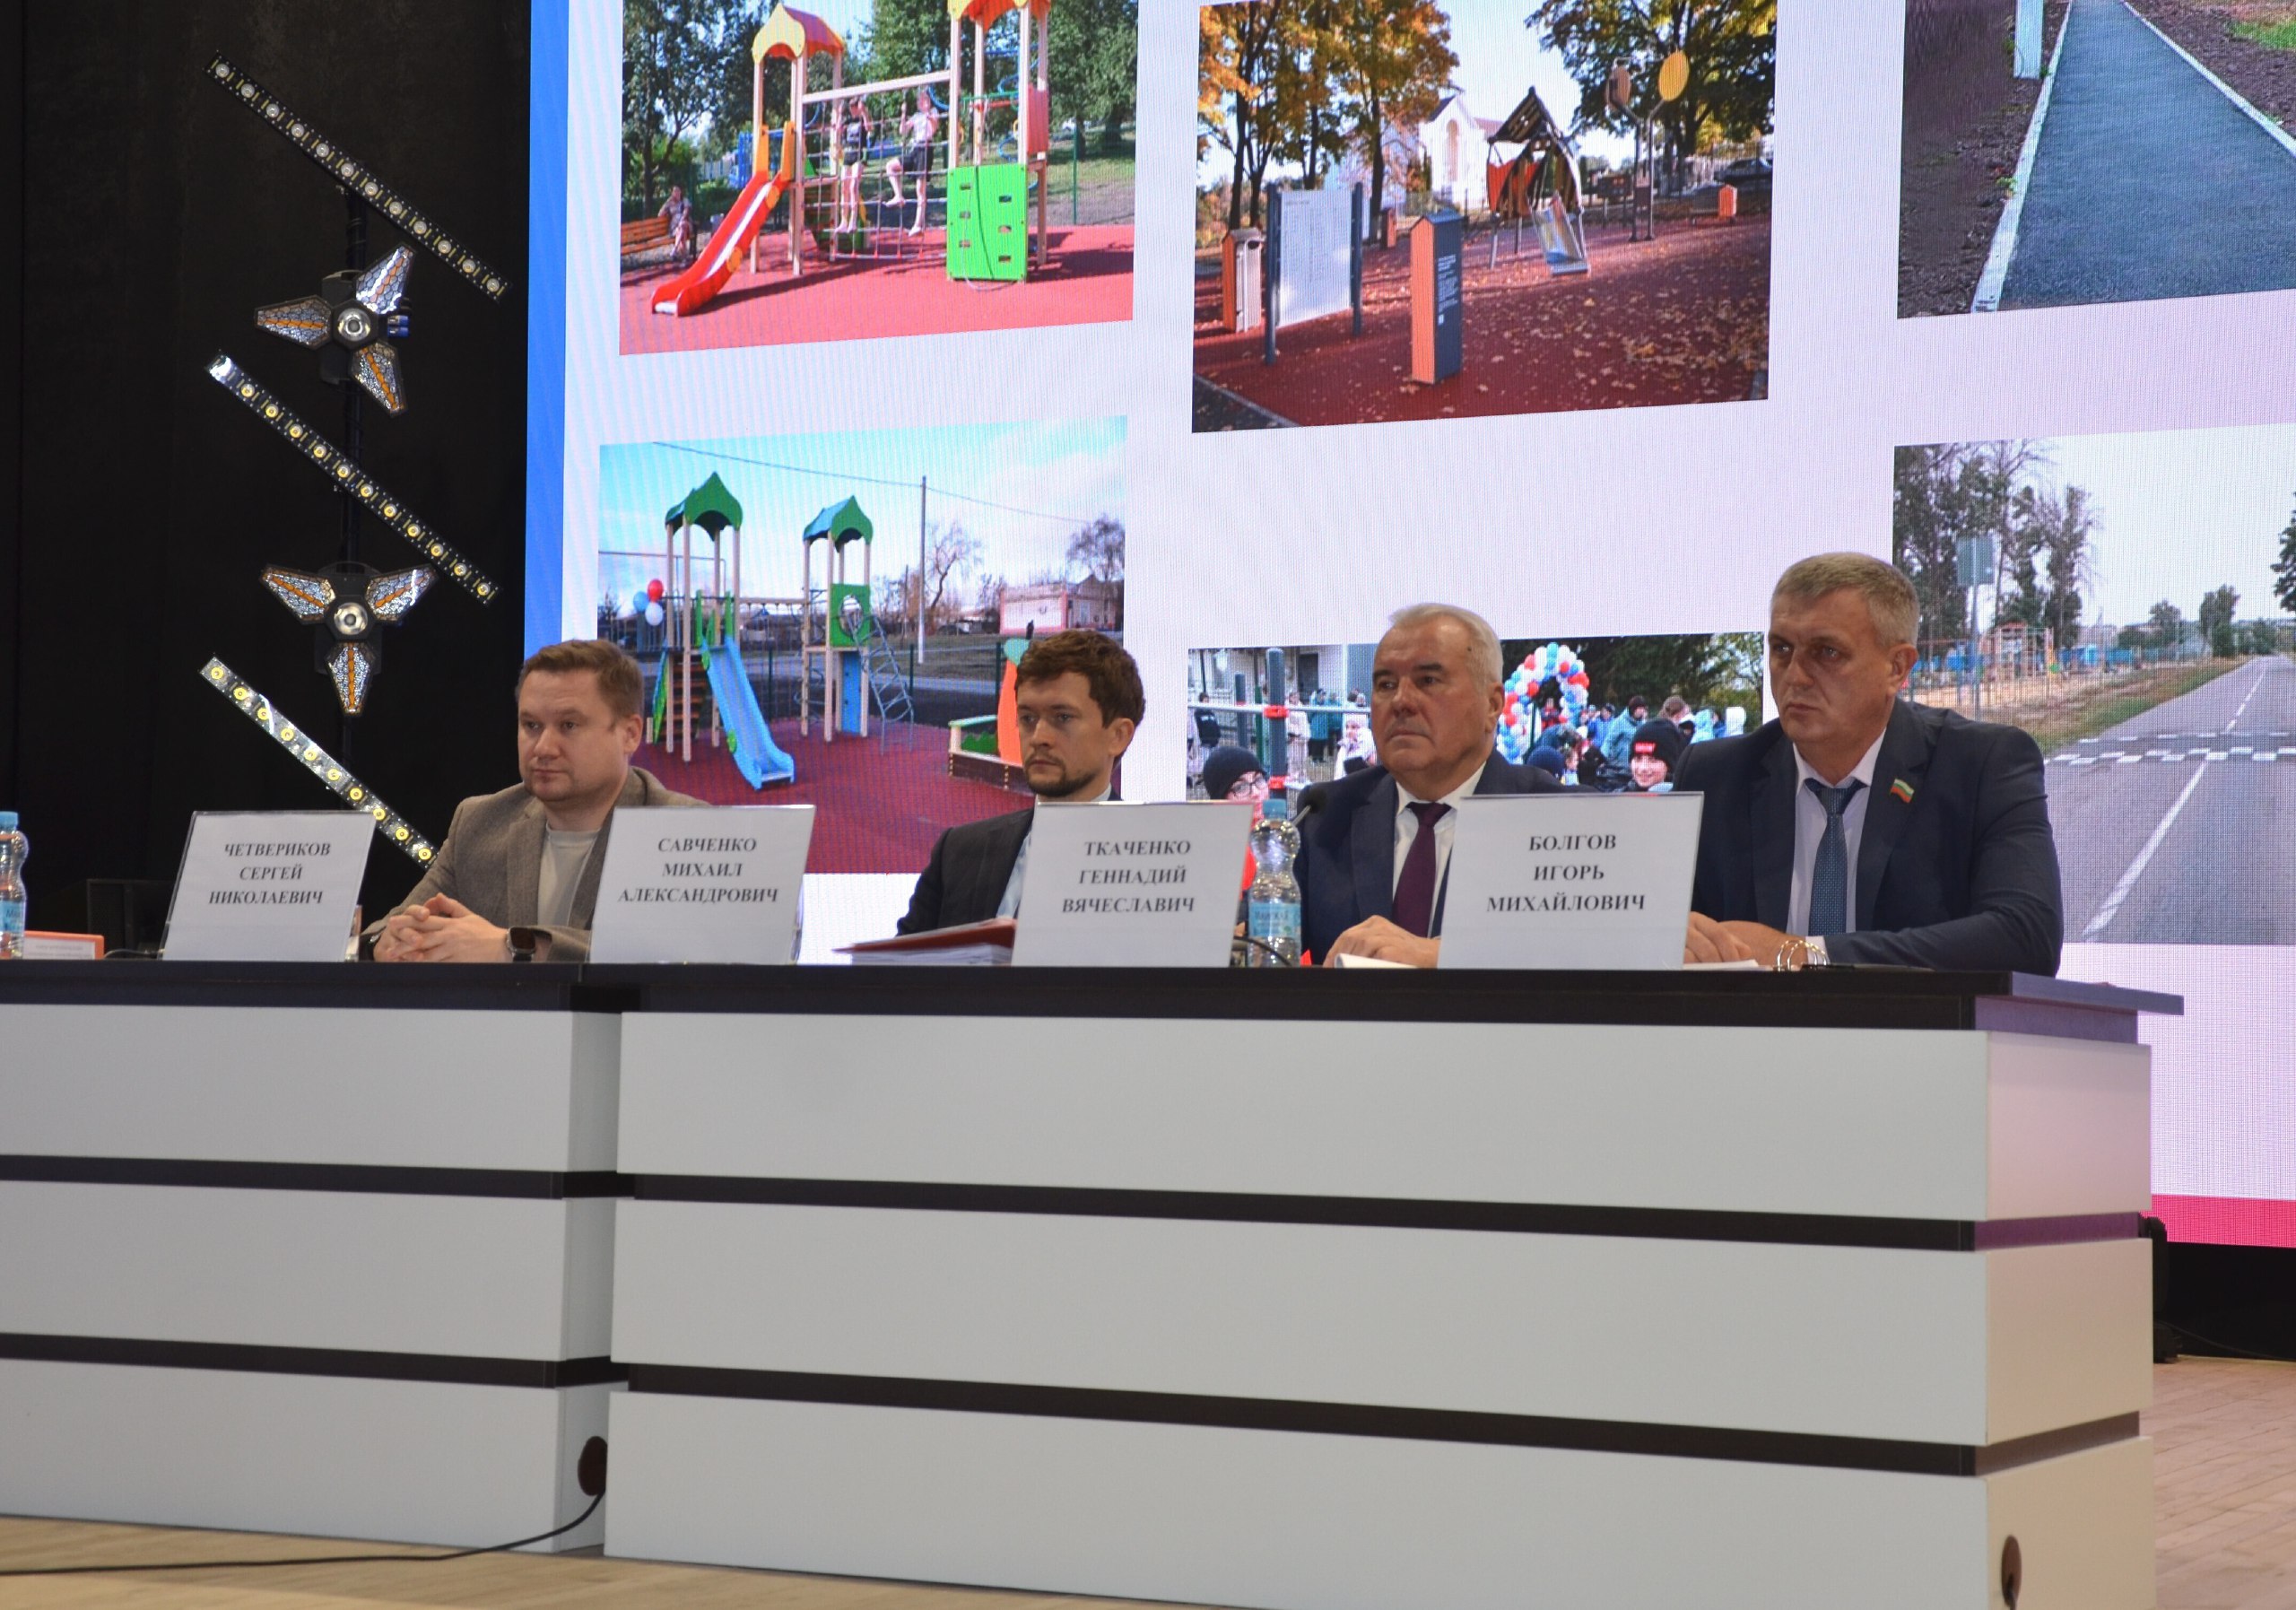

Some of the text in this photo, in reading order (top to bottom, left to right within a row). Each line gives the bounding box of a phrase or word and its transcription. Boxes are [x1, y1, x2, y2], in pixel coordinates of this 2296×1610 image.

[224, 842, 331, 857] ЧЕТВЕРИКОВ
[657, 838, 757, 853] САВЧЕНКО
[1085, 840, 1191, 856] ТКАЧЕНКО
[1529, 834, 1616, 851] БОЛГОВ
[239, 864, 303, 880] СЕРГЕЙ
[663, 863, 743, 877] МИХАИЛ
[1079, 866, 1187, 884] ГЕННАДИЙ
[1534, 865, 1605, 881] ИГОРЬ
[209, 891, 323, 904] НИКОЛАЕВИЧ
[619, 888, 778, 903] АЛЕКСАНДРОВИЧ
[1487, 892, 1645, 912] МИХАЙЛОВИЧ
[1062, 897, 1195, 913] ВЯЧЕСЛАВИЧ
